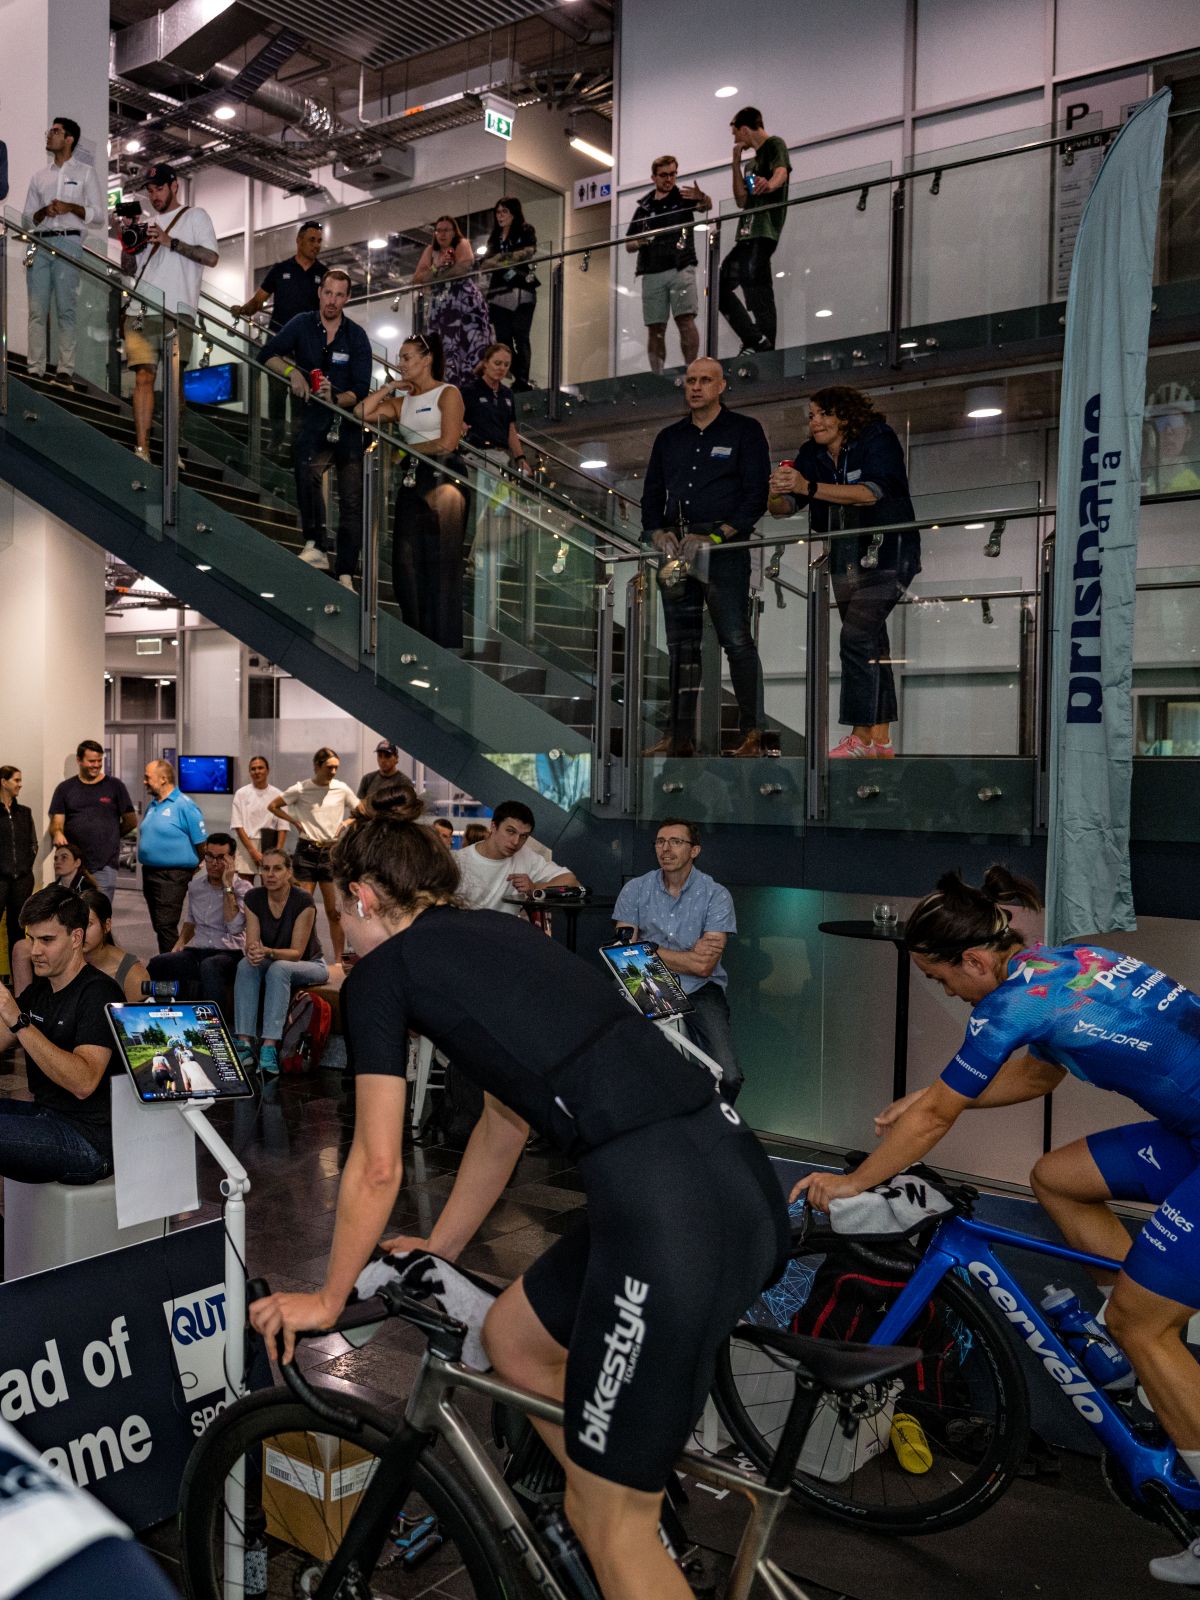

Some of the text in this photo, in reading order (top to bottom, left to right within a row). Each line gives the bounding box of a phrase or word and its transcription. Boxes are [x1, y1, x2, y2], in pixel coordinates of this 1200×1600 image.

[1066, 102, 1090, 131] P
[1087, 1028, 1153, 1052] CUORE
[171, 1292, 226, 1346] QUT
[968, 1261, 1104, 1424] cervélo
[82, 1315, 132, 1388] of
